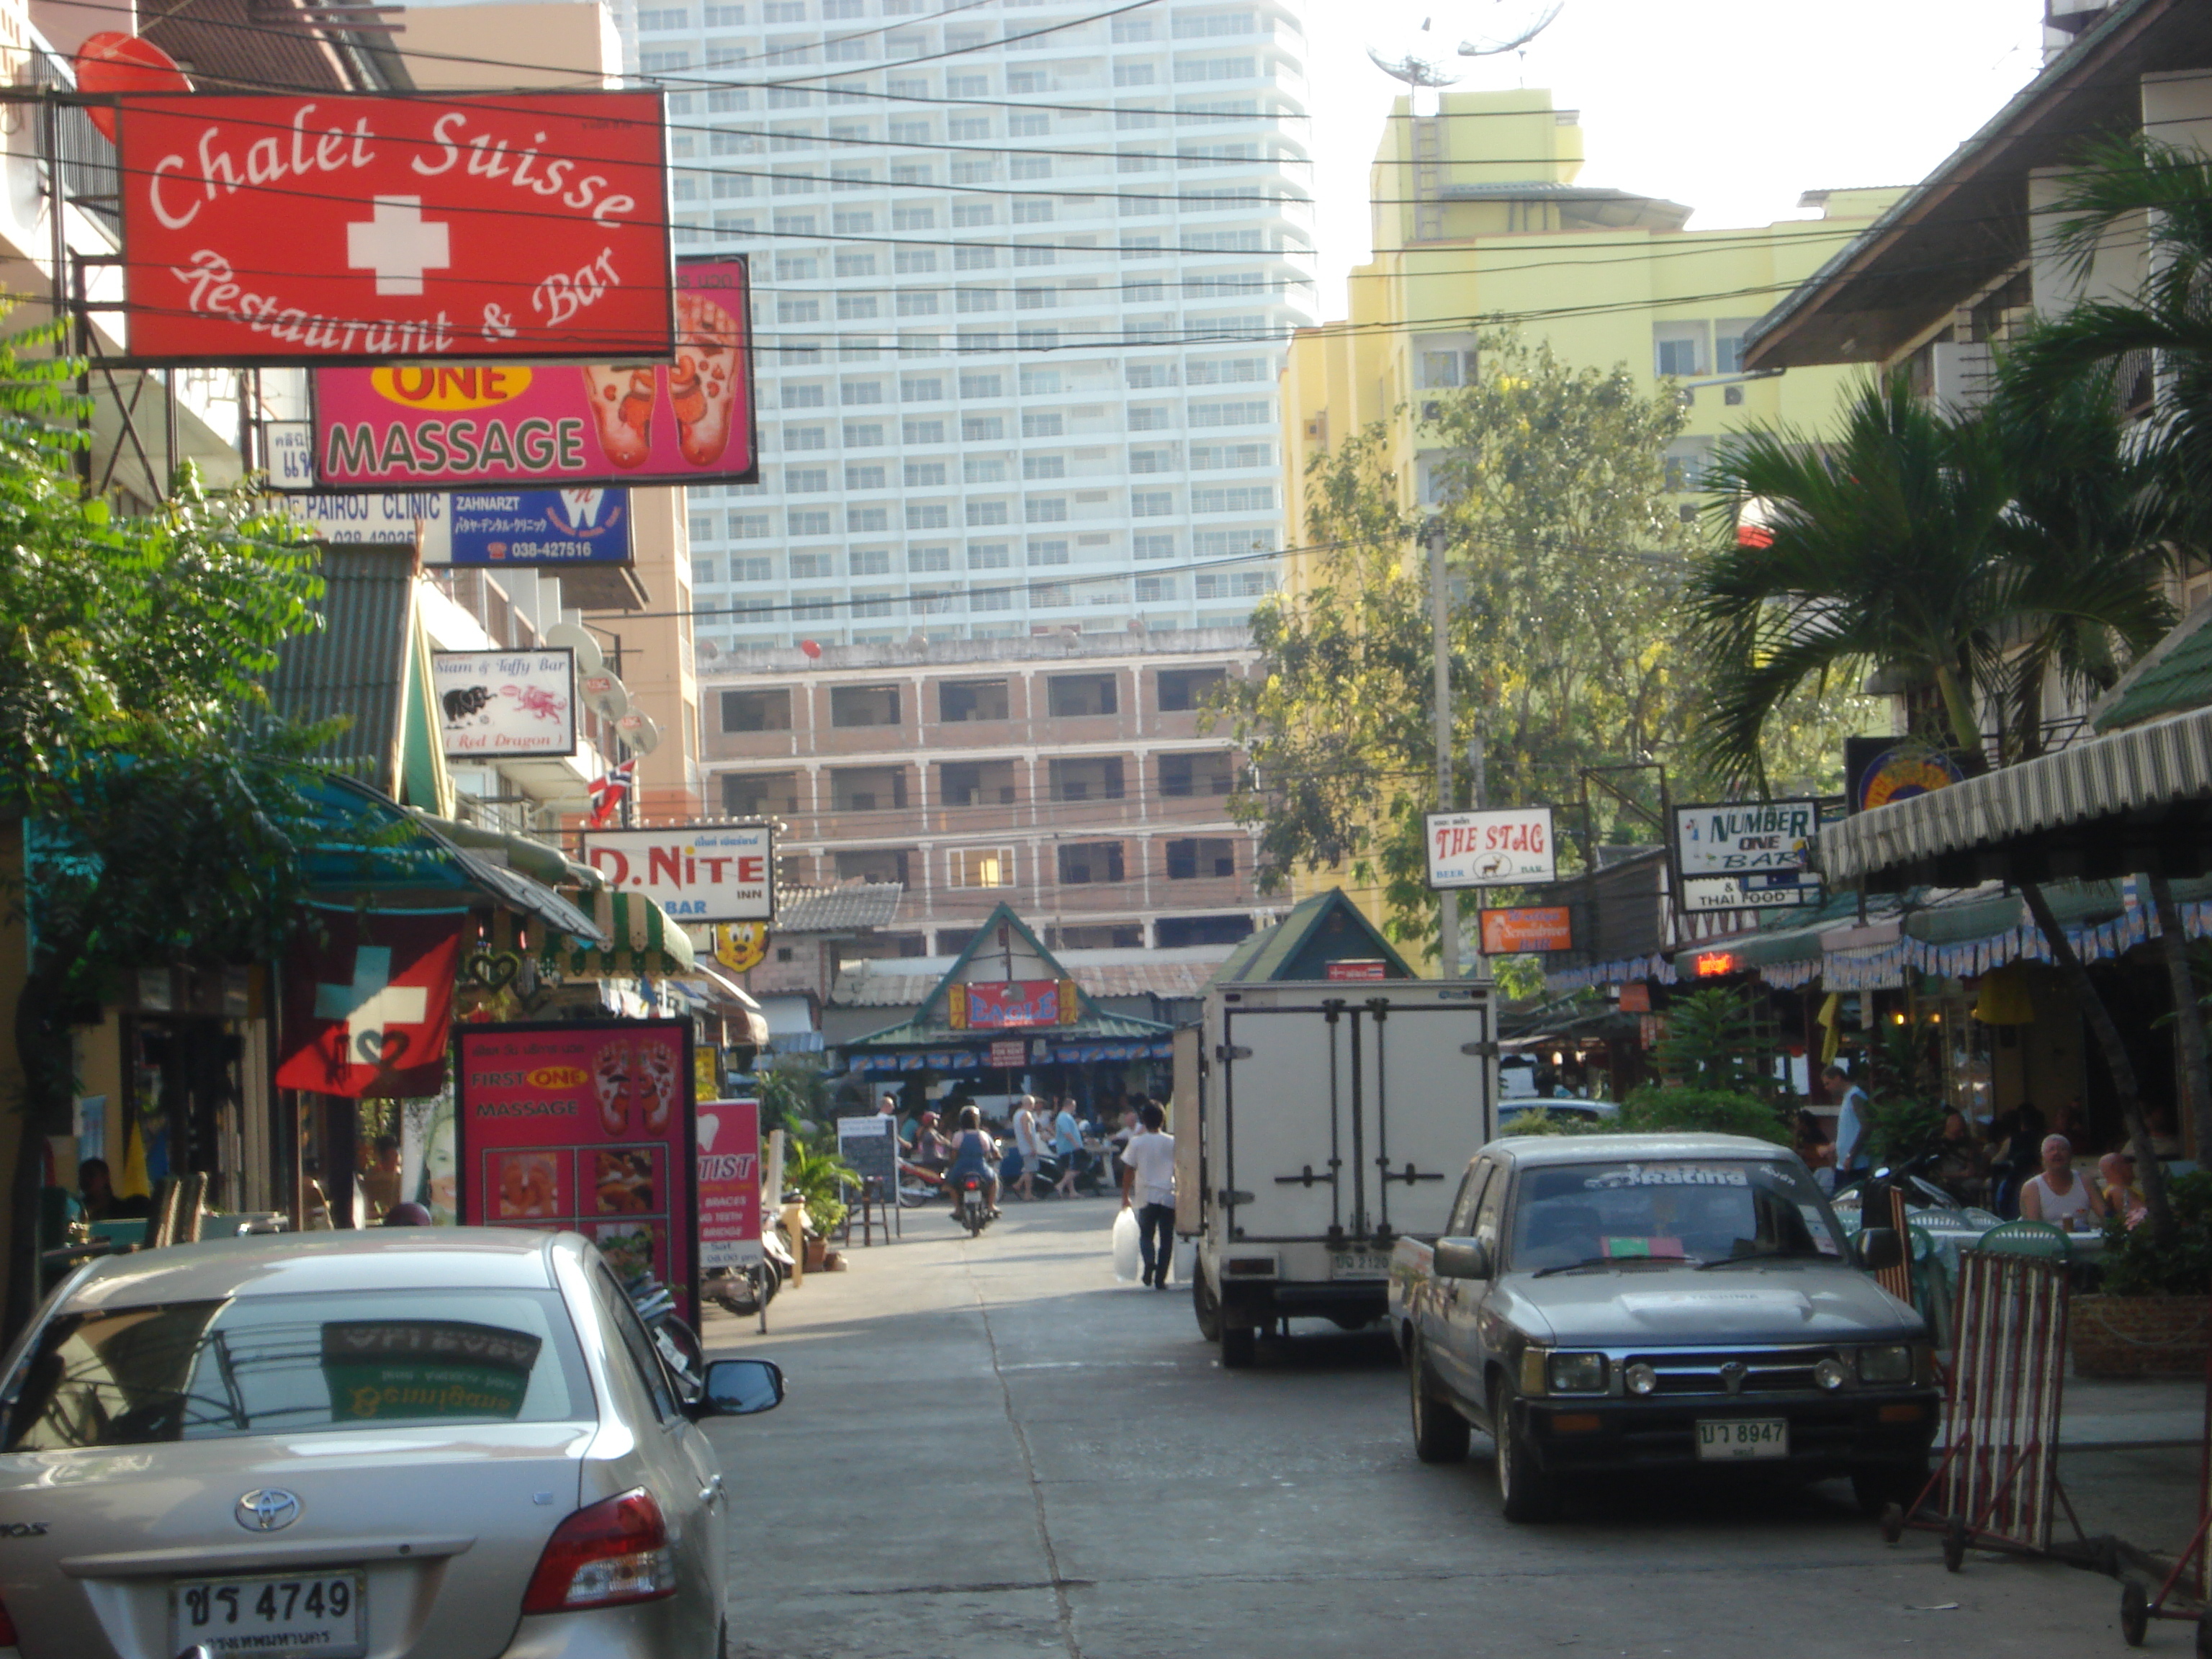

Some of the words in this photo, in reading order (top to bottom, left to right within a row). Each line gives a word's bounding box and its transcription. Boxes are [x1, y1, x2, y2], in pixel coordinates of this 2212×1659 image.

[148, 104, 376, 230] Chalet
[410, 112, 637, 229] Suisse
[169, 248, 454, 356] Restaurant
[481, 303, 517, 342] &
[532, 246, 622, 328] Bar
[392, 366, 508, 401] ONE
[327, 418, 586, 477] MASSAGE
[382, 493, 441, 521] CLINIC
[456, 496, 520, 512] ZAHNARZT
[511, 541, 592, 558] 038-427516
[436, 659, 472, 674] Siam
[495, 658, 531, 677] Taffy
[539, 657, 566, 672] Bar
[495, 732, 551, 750] Dragon
[1711, 811, 1808, 843] NUMBER
[1436, 827, 1478, 860] THE
[1485, 823, 1545, 854] STAG
[1739, 836, 1781, 850] ONE
[1722, 852, 1800, 868] BAR
[1437, 869, 1465, 878] BEER
[737, 889, 762, 900] INN
[1725, 882, 1734, 892] &
[665, 900, 707, 914] BAR
[1699, 894, 1735, 906] THAI
[1741, 891, 1786, 904] FOOD
[1519, 938, 1552, 951] BAR
[969, 990, 1057, 1022] EAGLE
[472, 1071, 526, 1087] FIRST
[534, 1069, 580, 1086] ONE
[477, 1100, 577, 1117] MASSAGE
[698, 1154, 756, 1182] TIST
[1737, 1423, 1783, 1443] 8947
[256, 1580, 350, 1622] 4749
